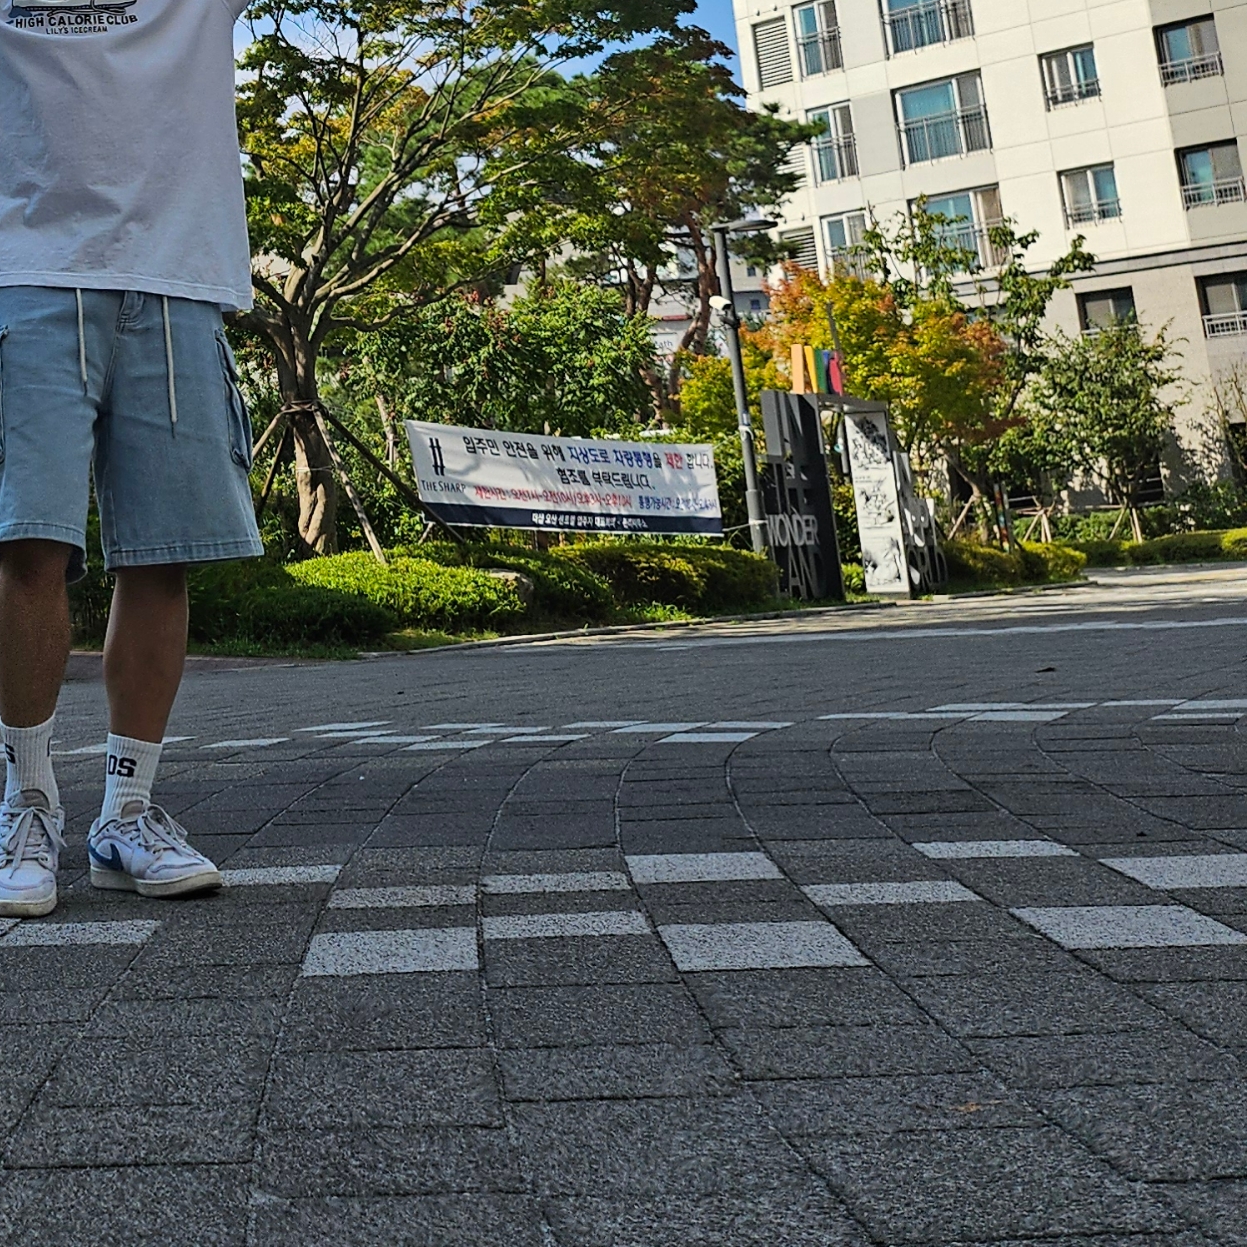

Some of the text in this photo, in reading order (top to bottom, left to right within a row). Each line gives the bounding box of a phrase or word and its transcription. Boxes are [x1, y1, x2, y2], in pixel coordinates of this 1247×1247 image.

[15, 14, 138, 28] HIGH CALORIE CLUB
[45, 25, 108, 34] LILY'S ICECREAM
[463, 435, 500, 456] 입주민
[503, 439, 539, 460] 안전을
[541, 443, 566, 462] 위해
[567, 445, 611, 465] 지상도로
[664, 452, 683, 470] 제한
[556, 467, 591, 486] 협조를
[765, 512, 820, 547] WONDER
